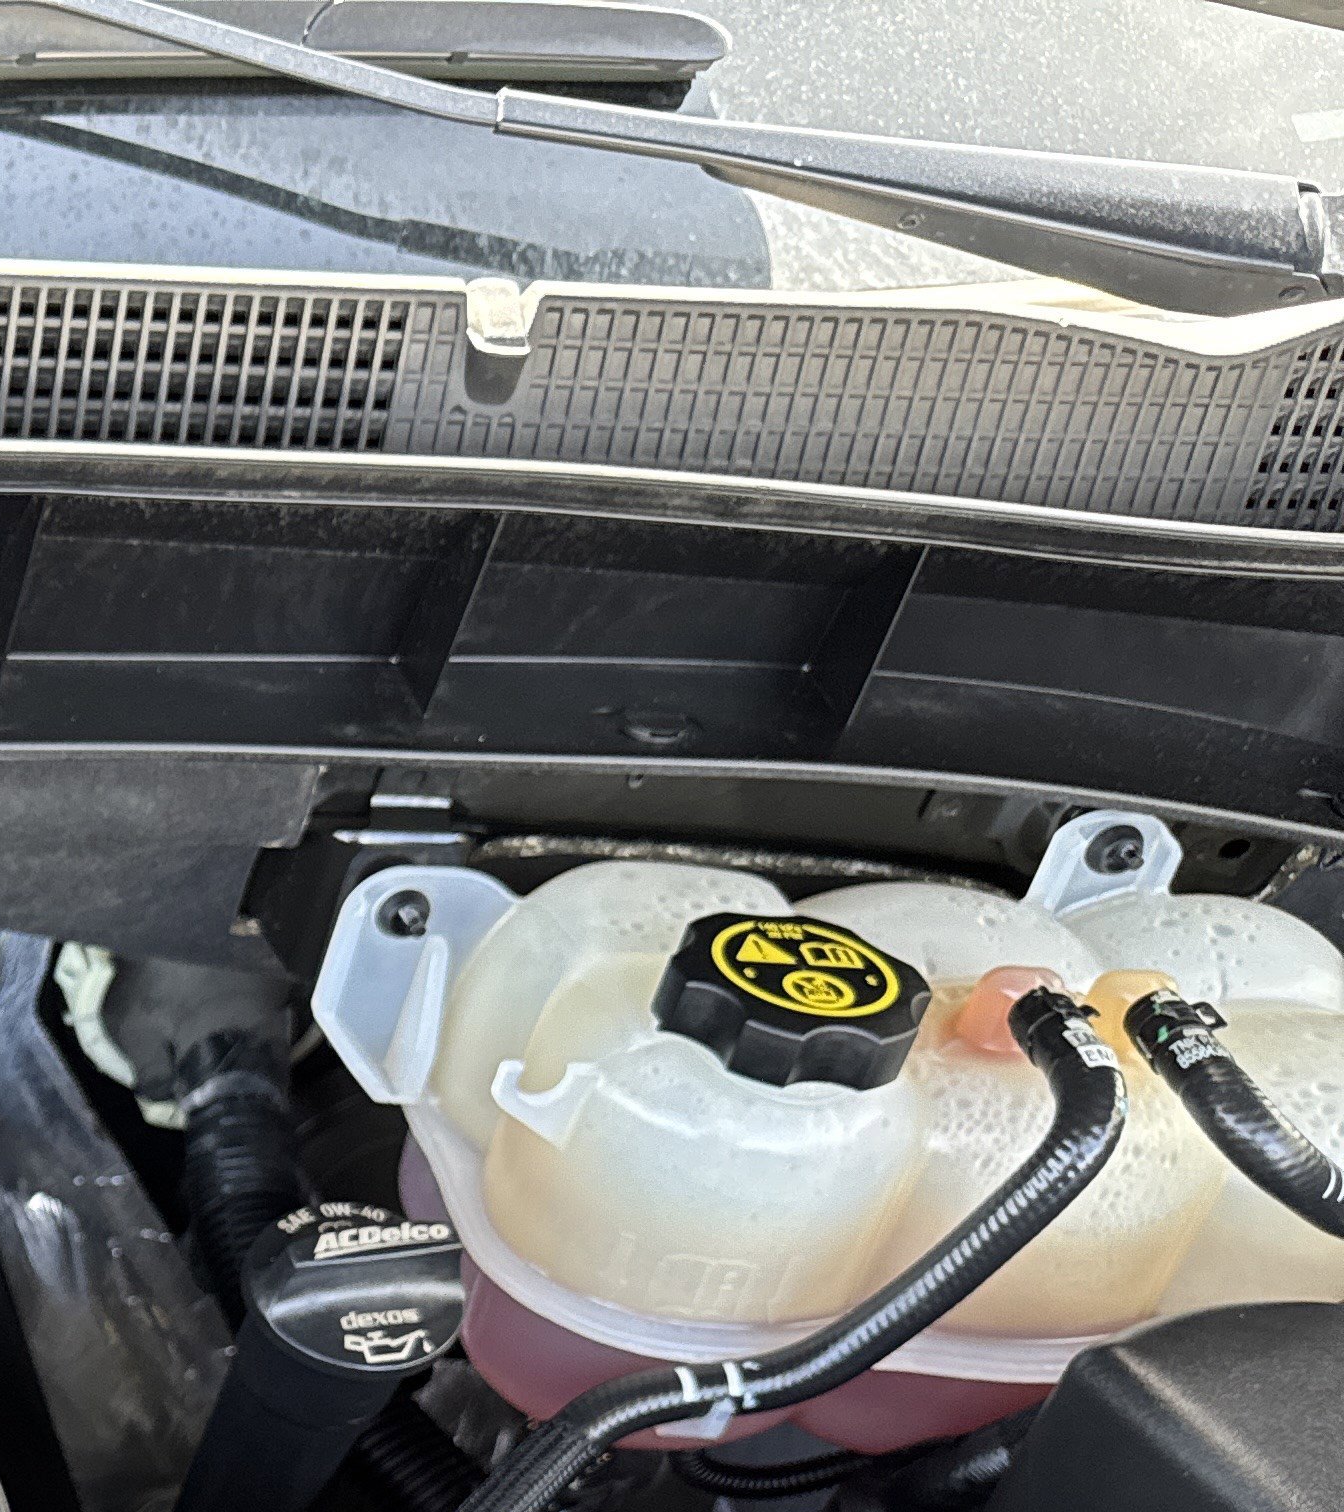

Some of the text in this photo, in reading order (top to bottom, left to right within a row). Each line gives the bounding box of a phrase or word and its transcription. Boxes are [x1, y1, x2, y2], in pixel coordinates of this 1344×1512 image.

[277, 1207, 316, 1234] SAE
[313, 1222, 450, 1259] ACDelco
[340, 1308, 421, 1331] dexos
